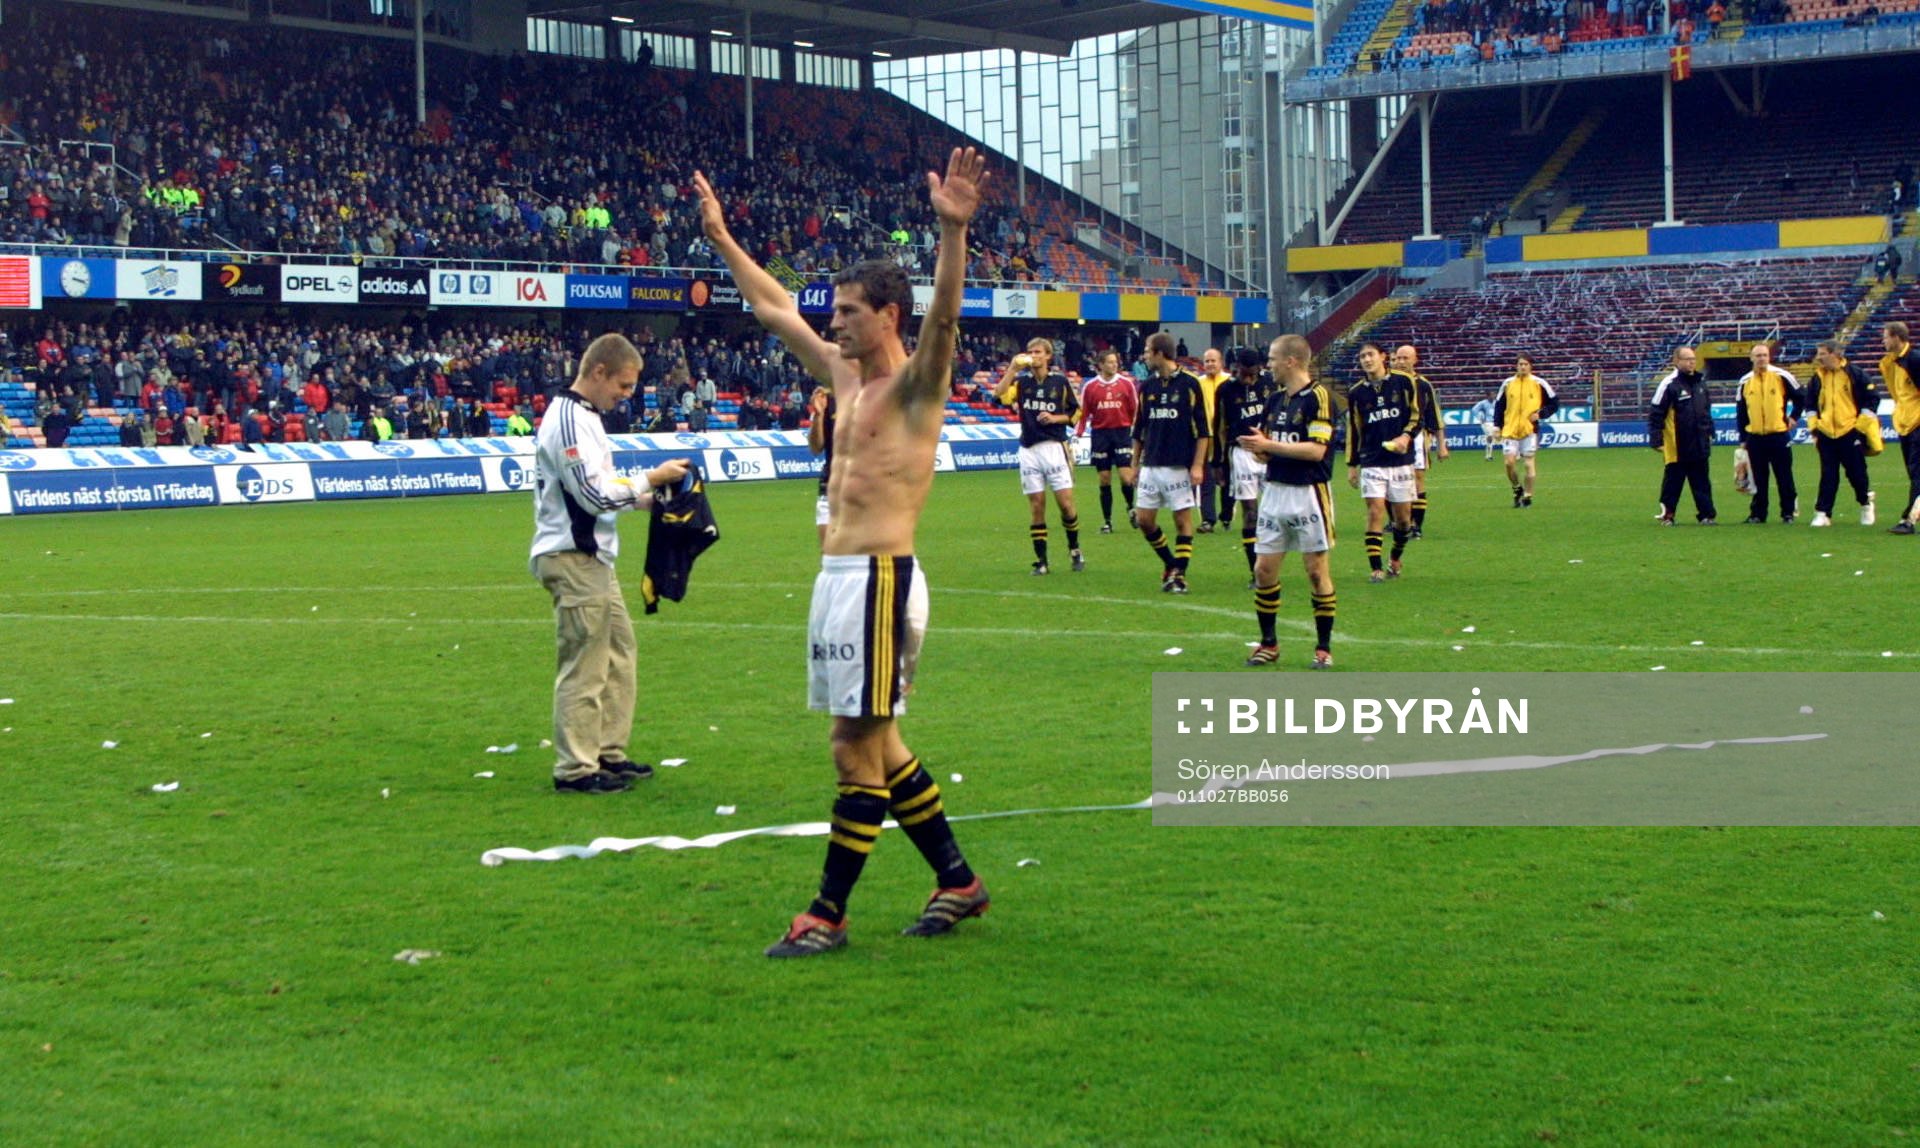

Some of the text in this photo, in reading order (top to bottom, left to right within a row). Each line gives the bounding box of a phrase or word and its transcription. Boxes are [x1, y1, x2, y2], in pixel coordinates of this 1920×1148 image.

[286, 276, 334, 291] OPEL
[361, 277, 408, 294] adidas
[517, 277, 547, 301] ICA
[570, 284, 622, 299] FOLKSAM
[631, 287, 671, 300] FALCON
[801, 289, 827, 306] SAS
[1271, 431, 1299, 443] BRO
[1539, 432, 1582, 445] EDS
[1602, 431, 1645, 444] Världens
[727, 460, 760, 475] EDS
[777, 459, 809, 473] Världens
[315, 471, 482, 494] Världens näst största IT-företag
[508, 469, 536, 486] ED
[246, 478, 294, 497] EDS
[14, 483, 214, 508] Världens näst största IT-företag
